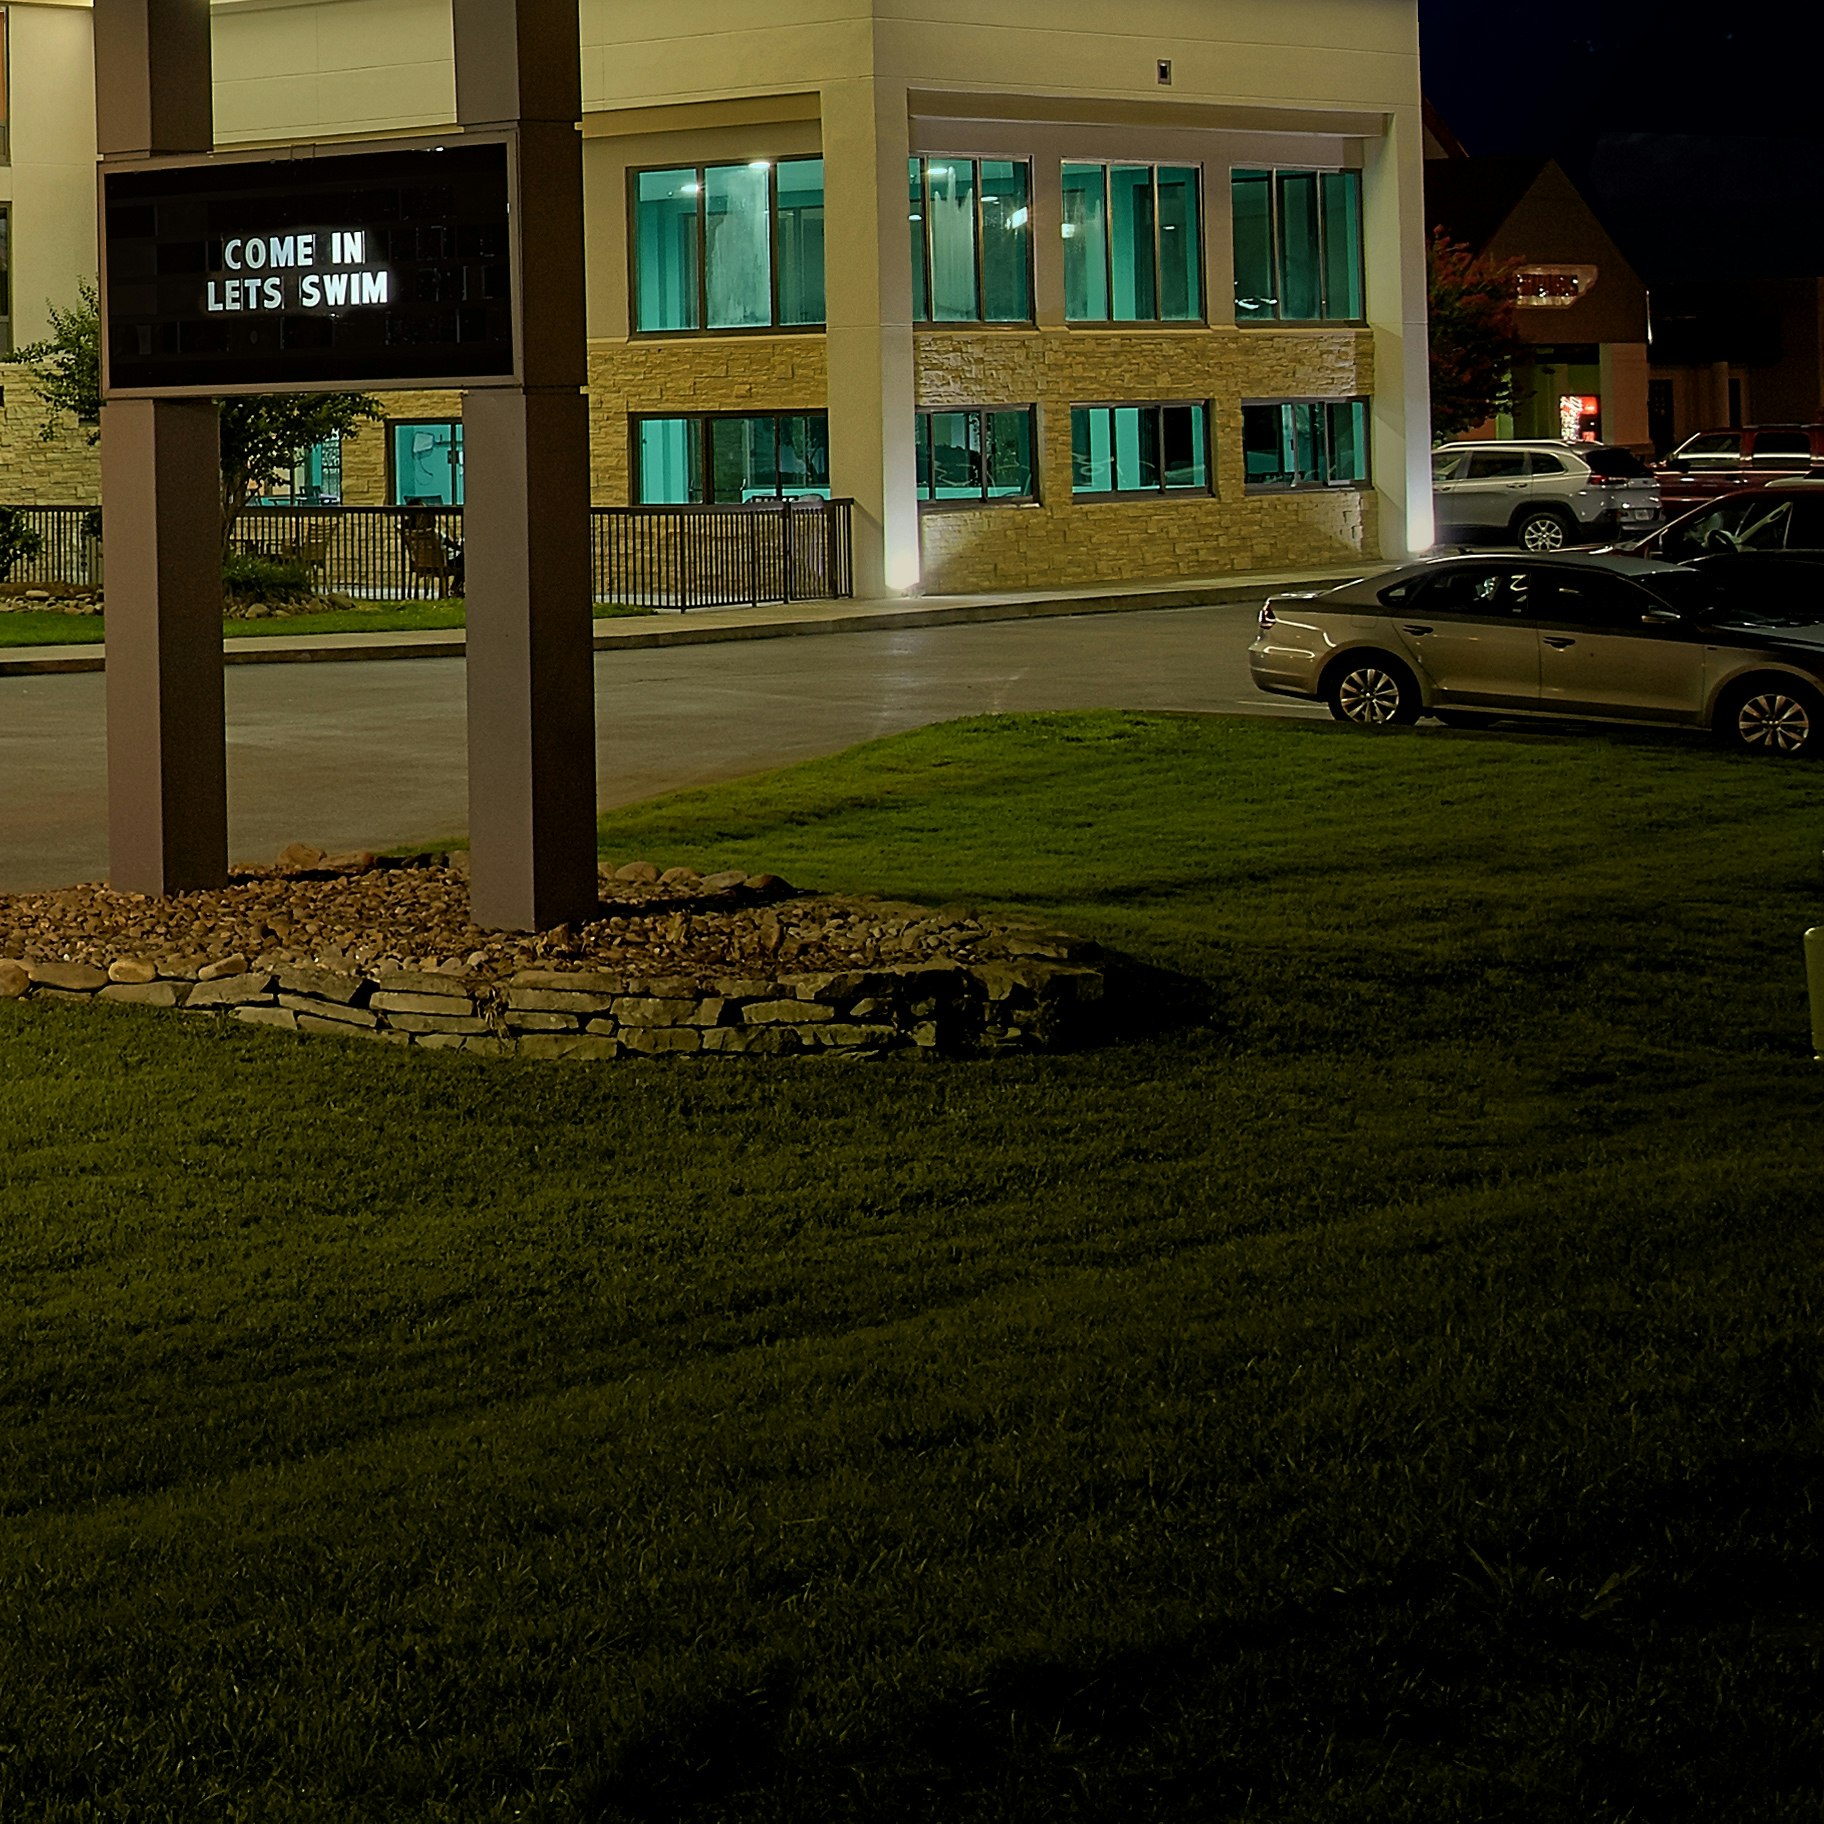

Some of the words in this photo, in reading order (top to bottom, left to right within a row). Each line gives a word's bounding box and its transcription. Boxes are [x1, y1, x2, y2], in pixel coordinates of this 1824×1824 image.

[224, 234, 313, 270] COME
[331, 231, 364, 265] IN
[207, 277, 282, 312] LETS
[301, 271, 388, 308] SWIM
